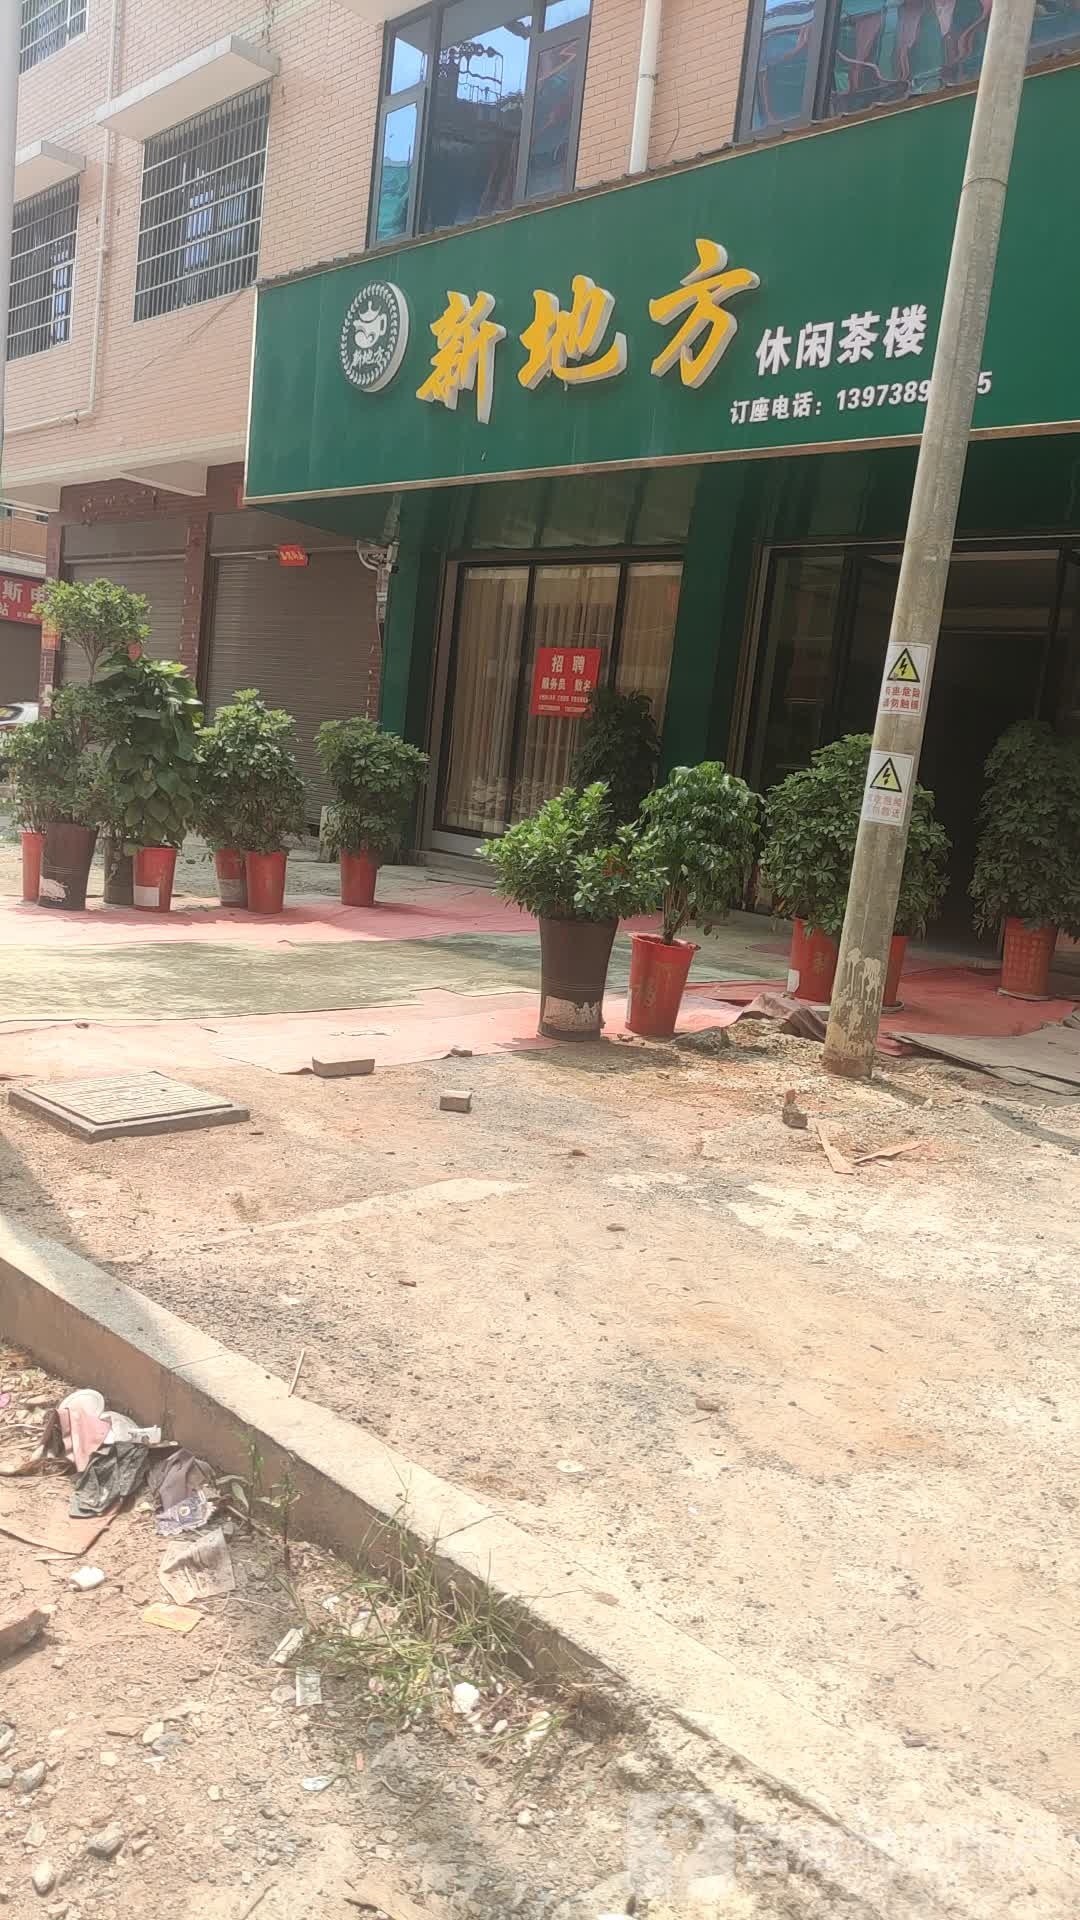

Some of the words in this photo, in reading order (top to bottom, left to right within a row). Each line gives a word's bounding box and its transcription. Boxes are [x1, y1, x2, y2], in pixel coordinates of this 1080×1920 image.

[415, 238, 761, 425] 新地方
[755, 304, 928, 376] 休闲茶楼
[351, 346, 384, 369] 新地方
[730, 391, 823, 424] 订座电话：
[836, 371, 993, 412] 13973895
[541, 677, 566, 690] 服务员
[551, 655, 585, 674] 招聘
